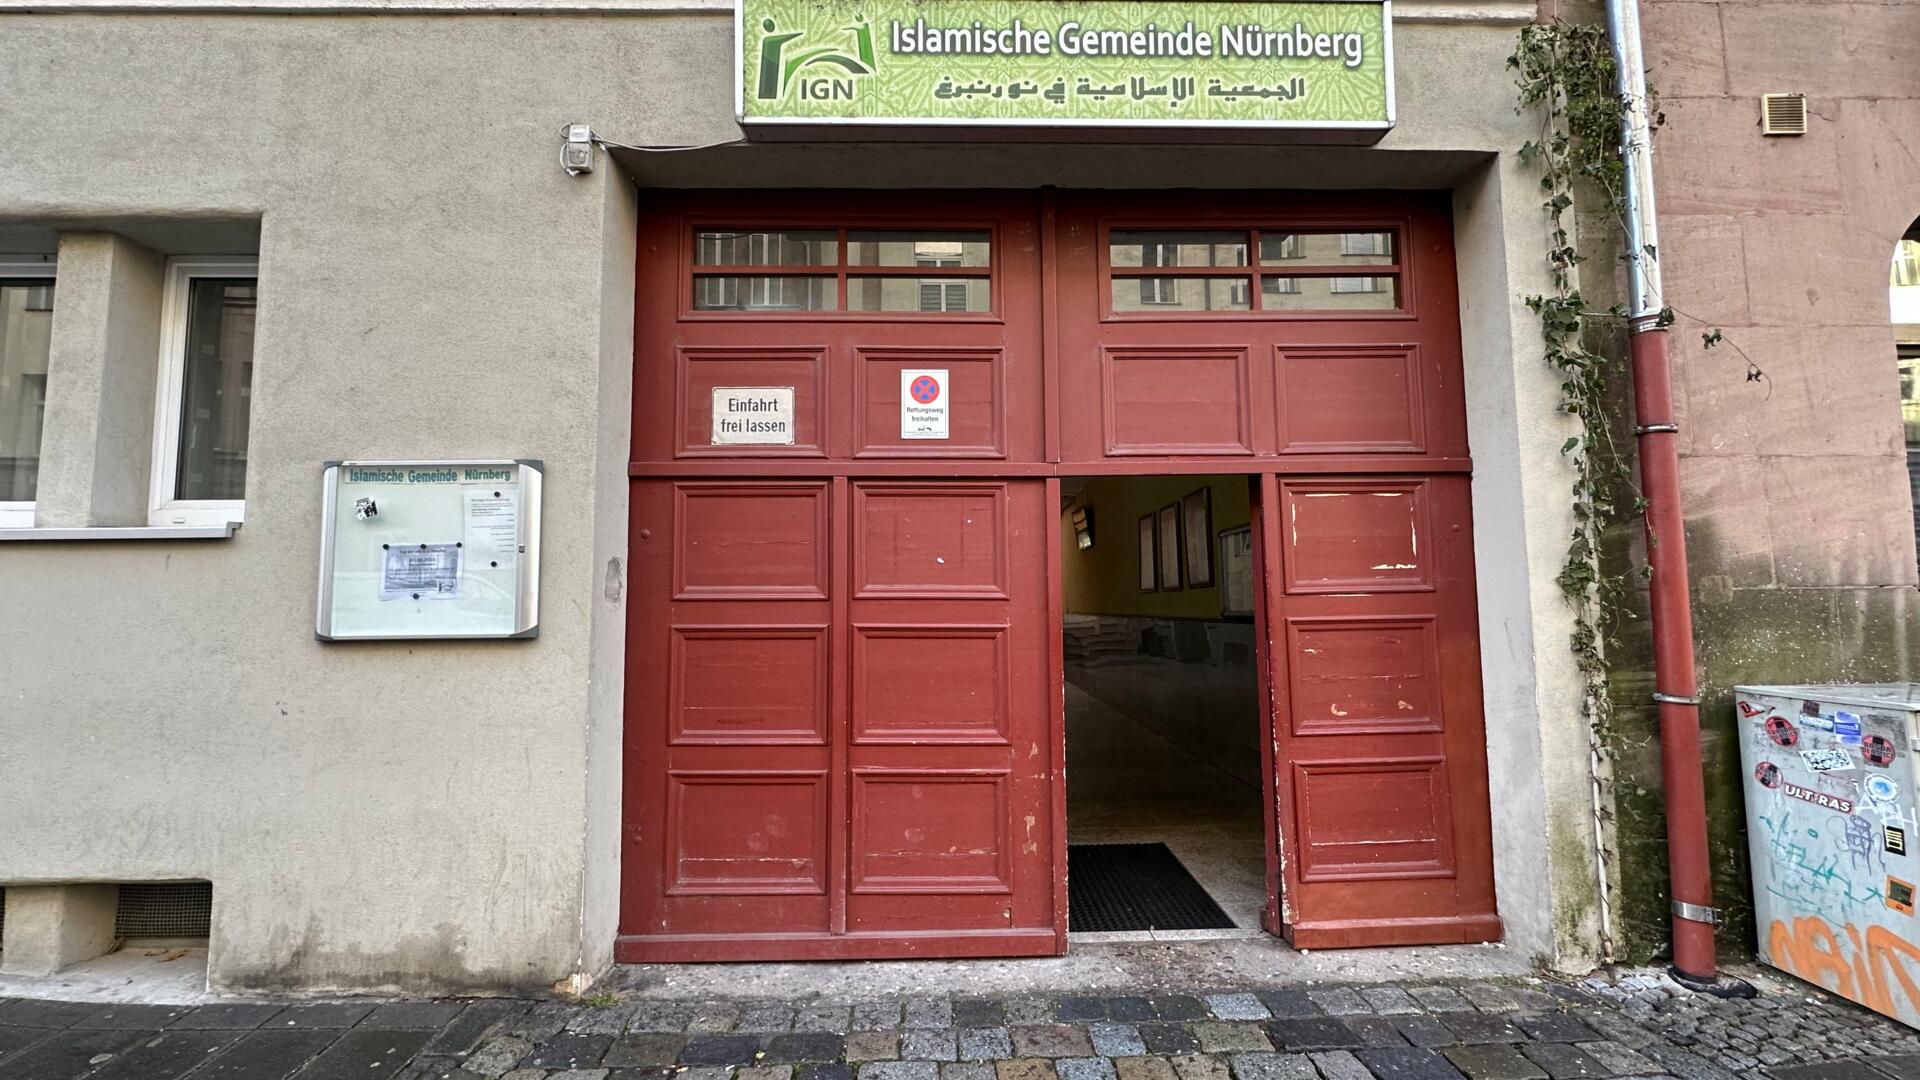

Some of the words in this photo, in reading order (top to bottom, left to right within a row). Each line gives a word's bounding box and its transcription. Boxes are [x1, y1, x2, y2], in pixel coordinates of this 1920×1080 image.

[892, 18, 1051, 54] Islamische
[1058, 22, 1212, 57] Gemeinde
[1221, 23, 1362, 67] Nürnberg
[801, 79, 853, 100] IGN
[1043, 77, 1066, 105] في
[1076, 77, 1195, 107] الإسلامية
[1208, 78, 1305, 102] الجمعية
[728, 398, 778, 412] Einfahrt
[721, 419, 742, 433] frei
[746, 418, 786, 433] lassen
[350, 469, 404, 482] Islamische
[408, 470, 458, 483] Gemeinde
[464, 469, 511, 481] Nürnberg
[1785, 785, 1852, 812] ULTRAS
